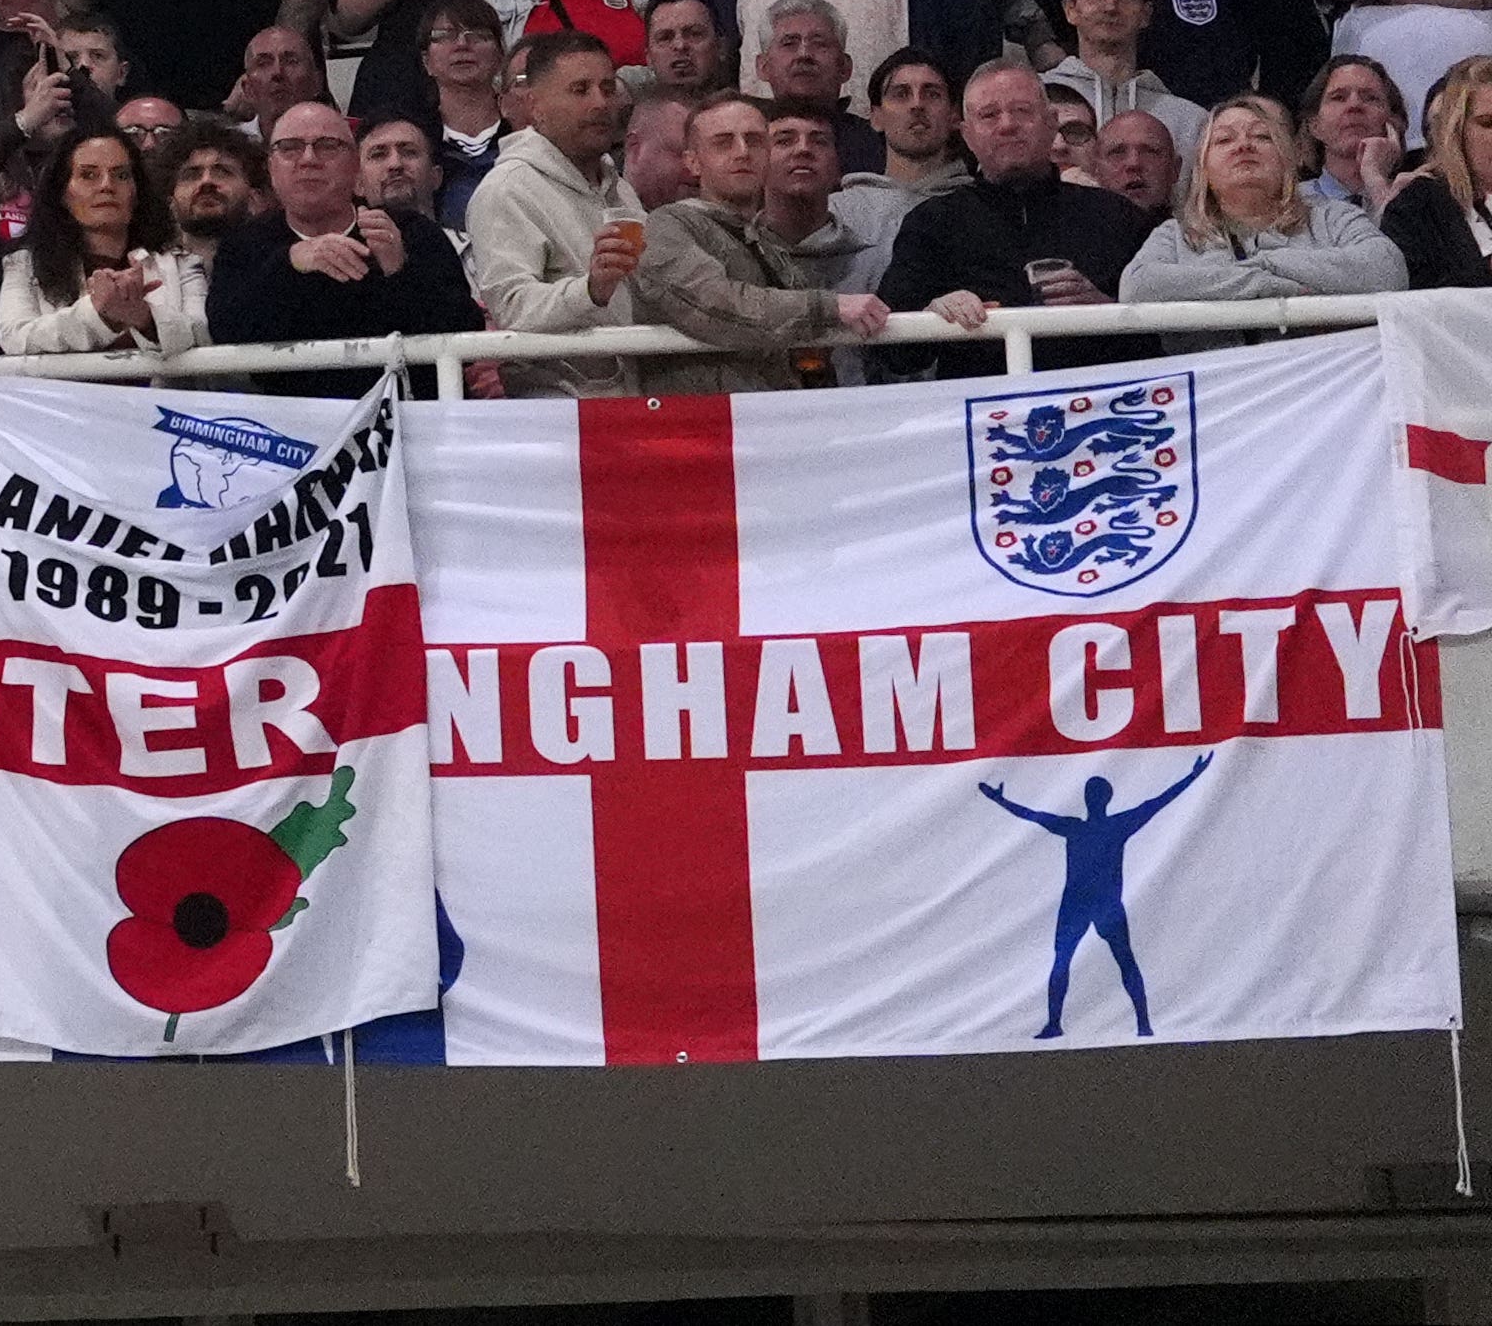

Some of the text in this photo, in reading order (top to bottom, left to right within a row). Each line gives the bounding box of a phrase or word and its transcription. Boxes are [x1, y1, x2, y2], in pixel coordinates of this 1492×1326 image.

[169, 415, 311, 464] BIRMINGHAM CITY
[1, 548, 181, 630] 1989
[429, 597, 1399, 765] NGHAM CITY
